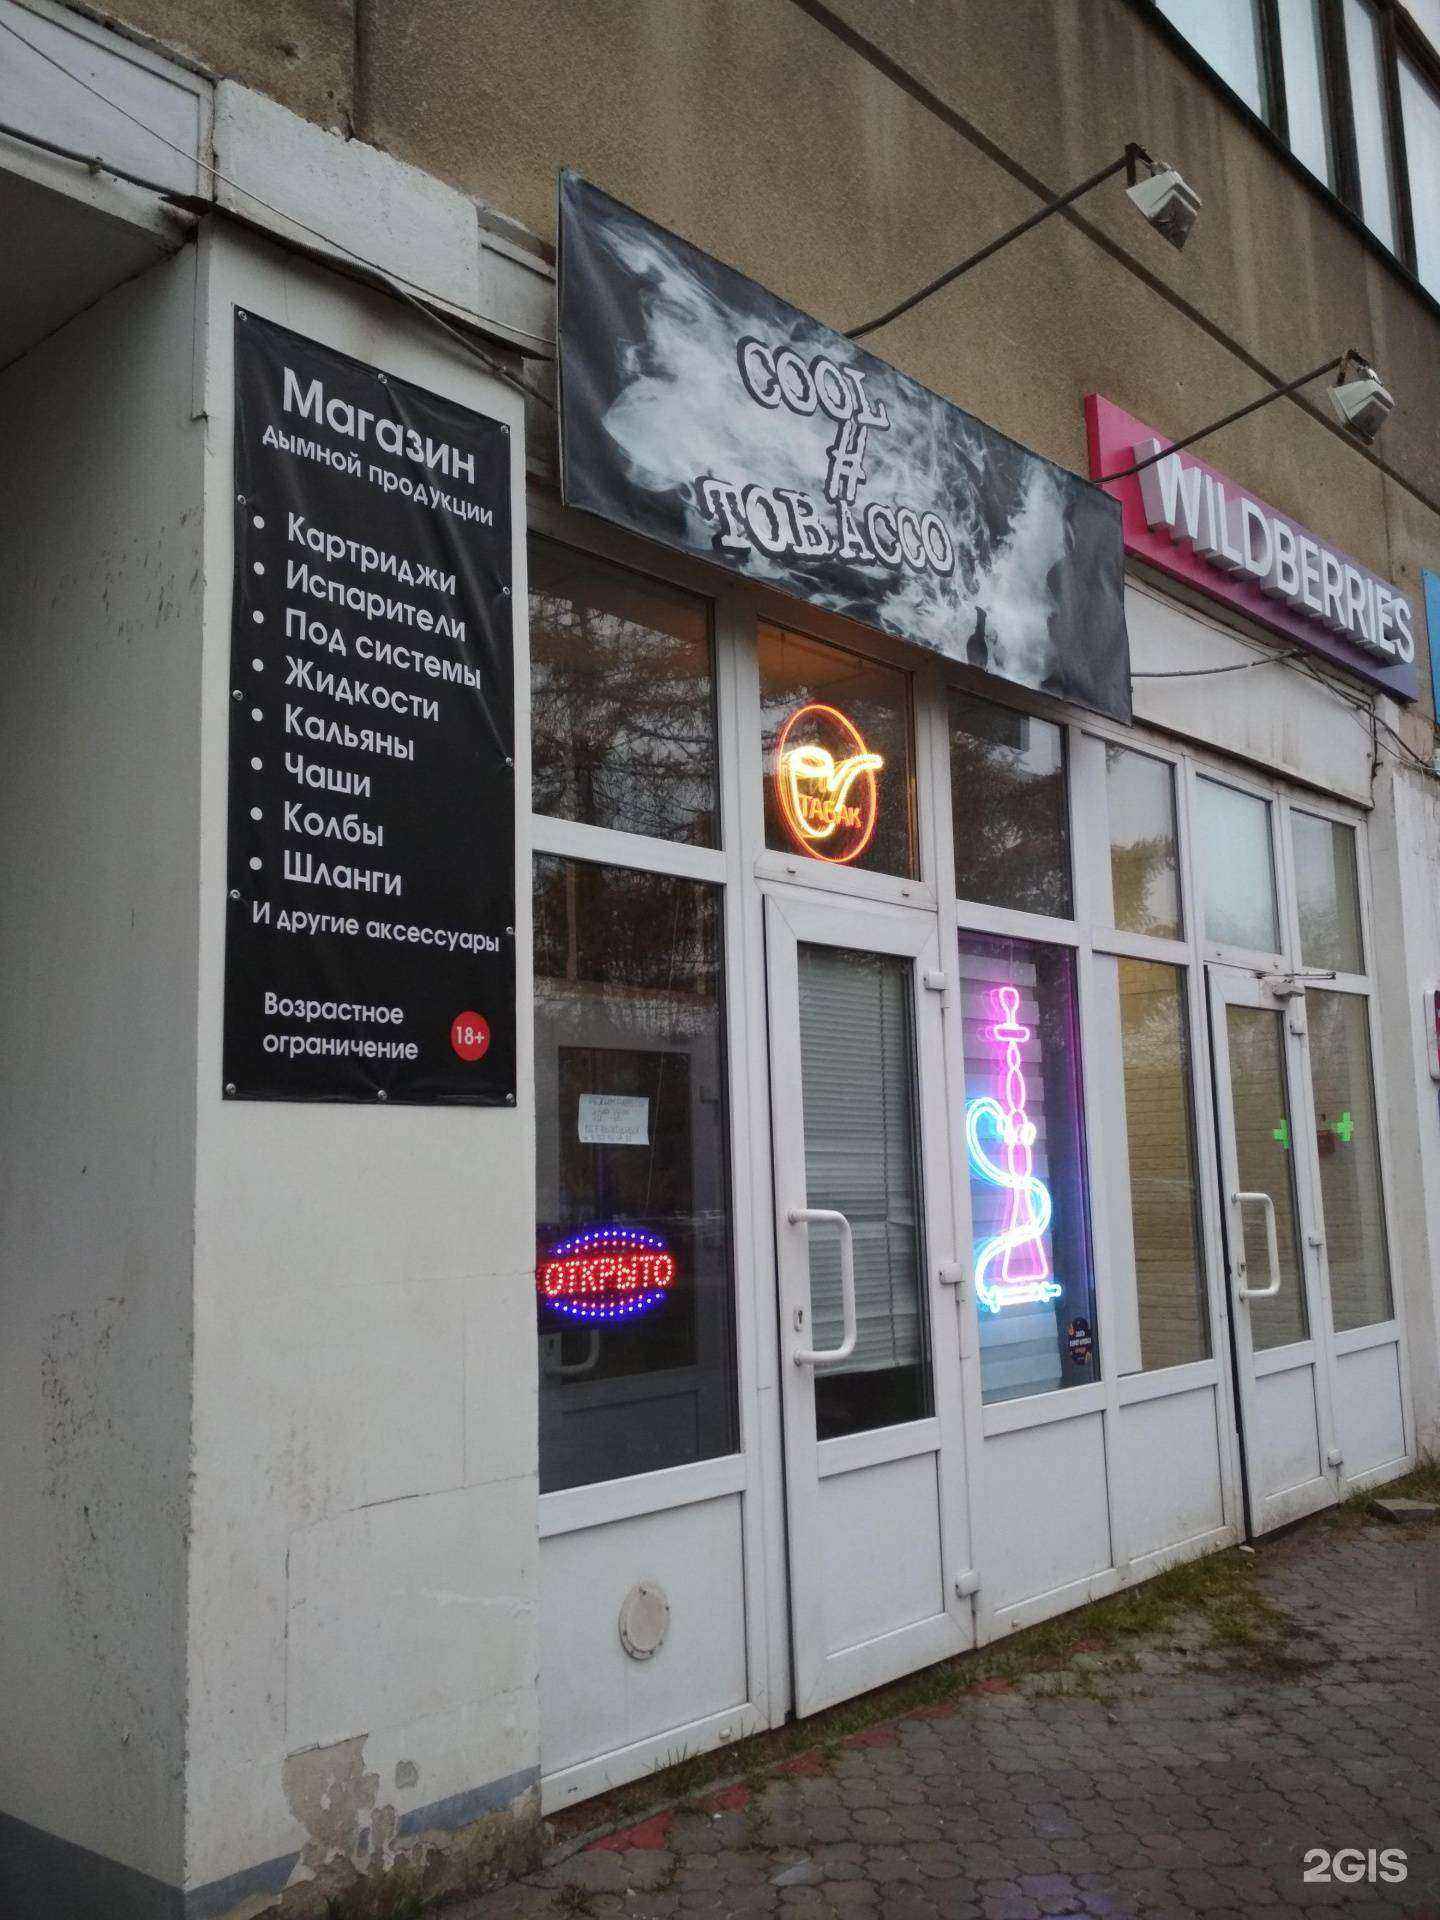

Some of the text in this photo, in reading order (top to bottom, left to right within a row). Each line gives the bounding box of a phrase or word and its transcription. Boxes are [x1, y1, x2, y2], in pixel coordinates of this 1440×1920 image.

[737, 337, 890, 431] COOL
[283, 366, 476, 485] Магазин
[262, 424, 494, 528] дымной продукции
[288, 512, 457, 596] Картриджи
[701, 477, 954, 577] TOBACCO
[1145, 437, 1415, 664] WILDBERRIES
[286, 560, 466, 642] Испарители
[286, 608, 481, 690] Под системы
[285, 655, 439, 722] Жидкости
[285, 704, 415, 762] Кальяны
[284, 752, 371, 798] Чаши
[284, 801, 384, 847] Колбы
[284, 850, 402, 897] Шланги
[252, 901, 500, 954] И другие аксессуары
[264, 992, 404, 1025] Возрастное
[456, 1026, 485, 1046] 18+
[262, 1034, 419, 1061] ограничение
[544, 1254, 673, 1295] ОТКРЫТО
